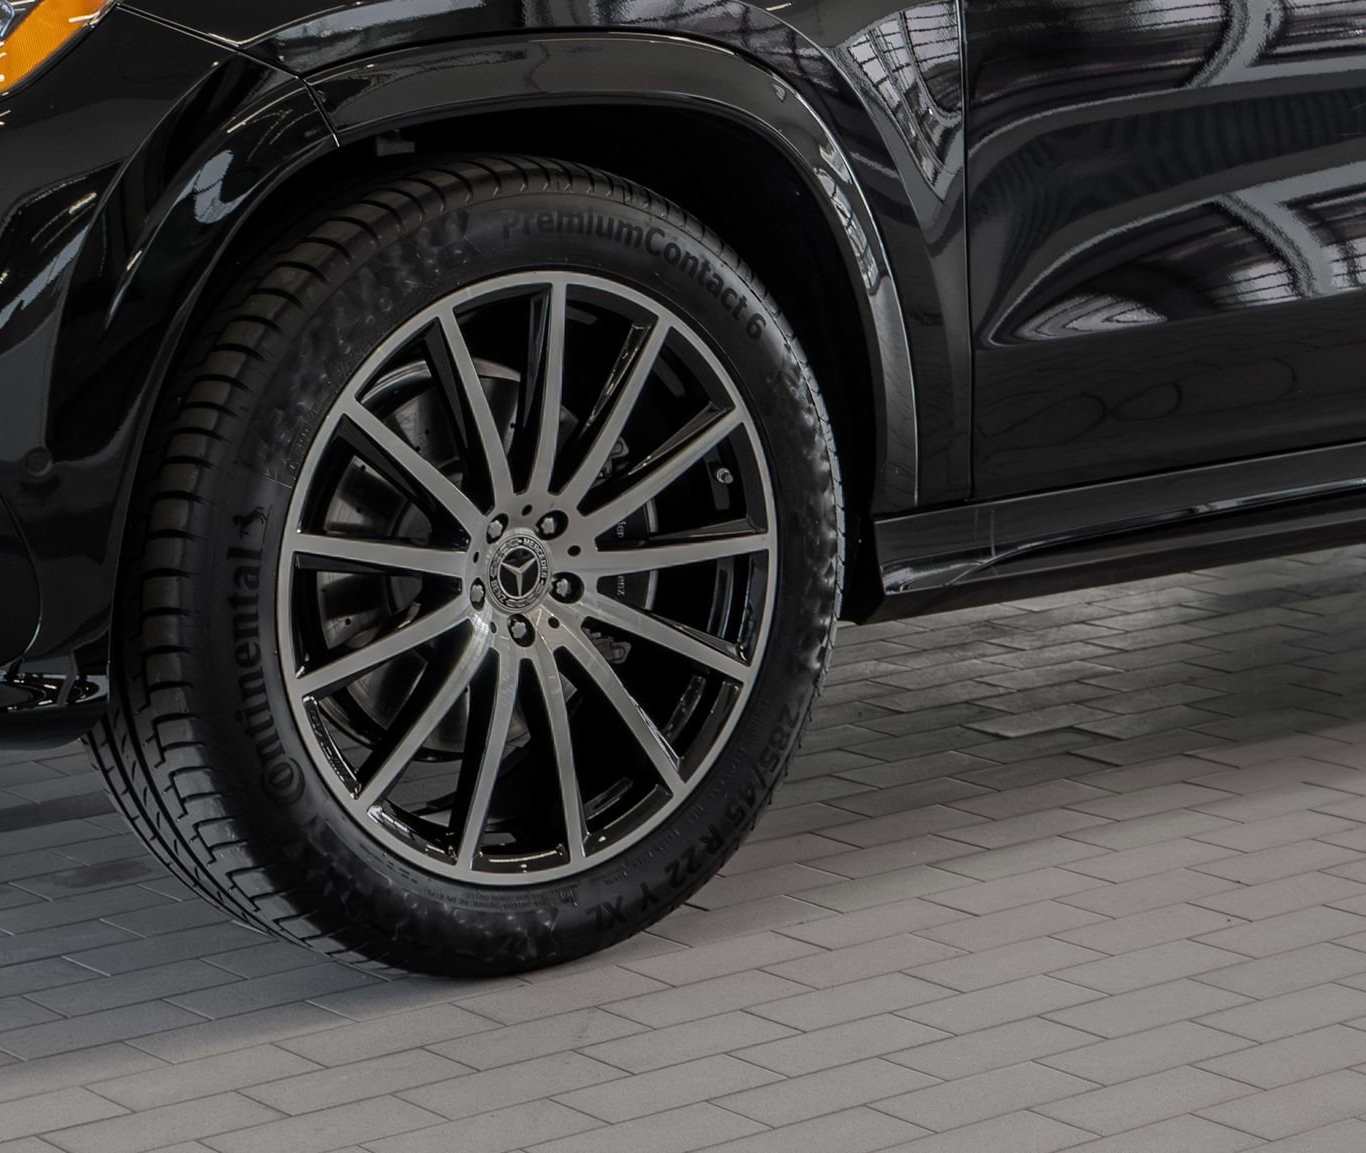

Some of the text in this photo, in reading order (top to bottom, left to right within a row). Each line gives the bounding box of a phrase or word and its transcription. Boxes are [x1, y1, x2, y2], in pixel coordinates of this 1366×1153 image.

[502, 207, 768, 340] PremiumContact 6
[228, 547, 305, 806] Continental
